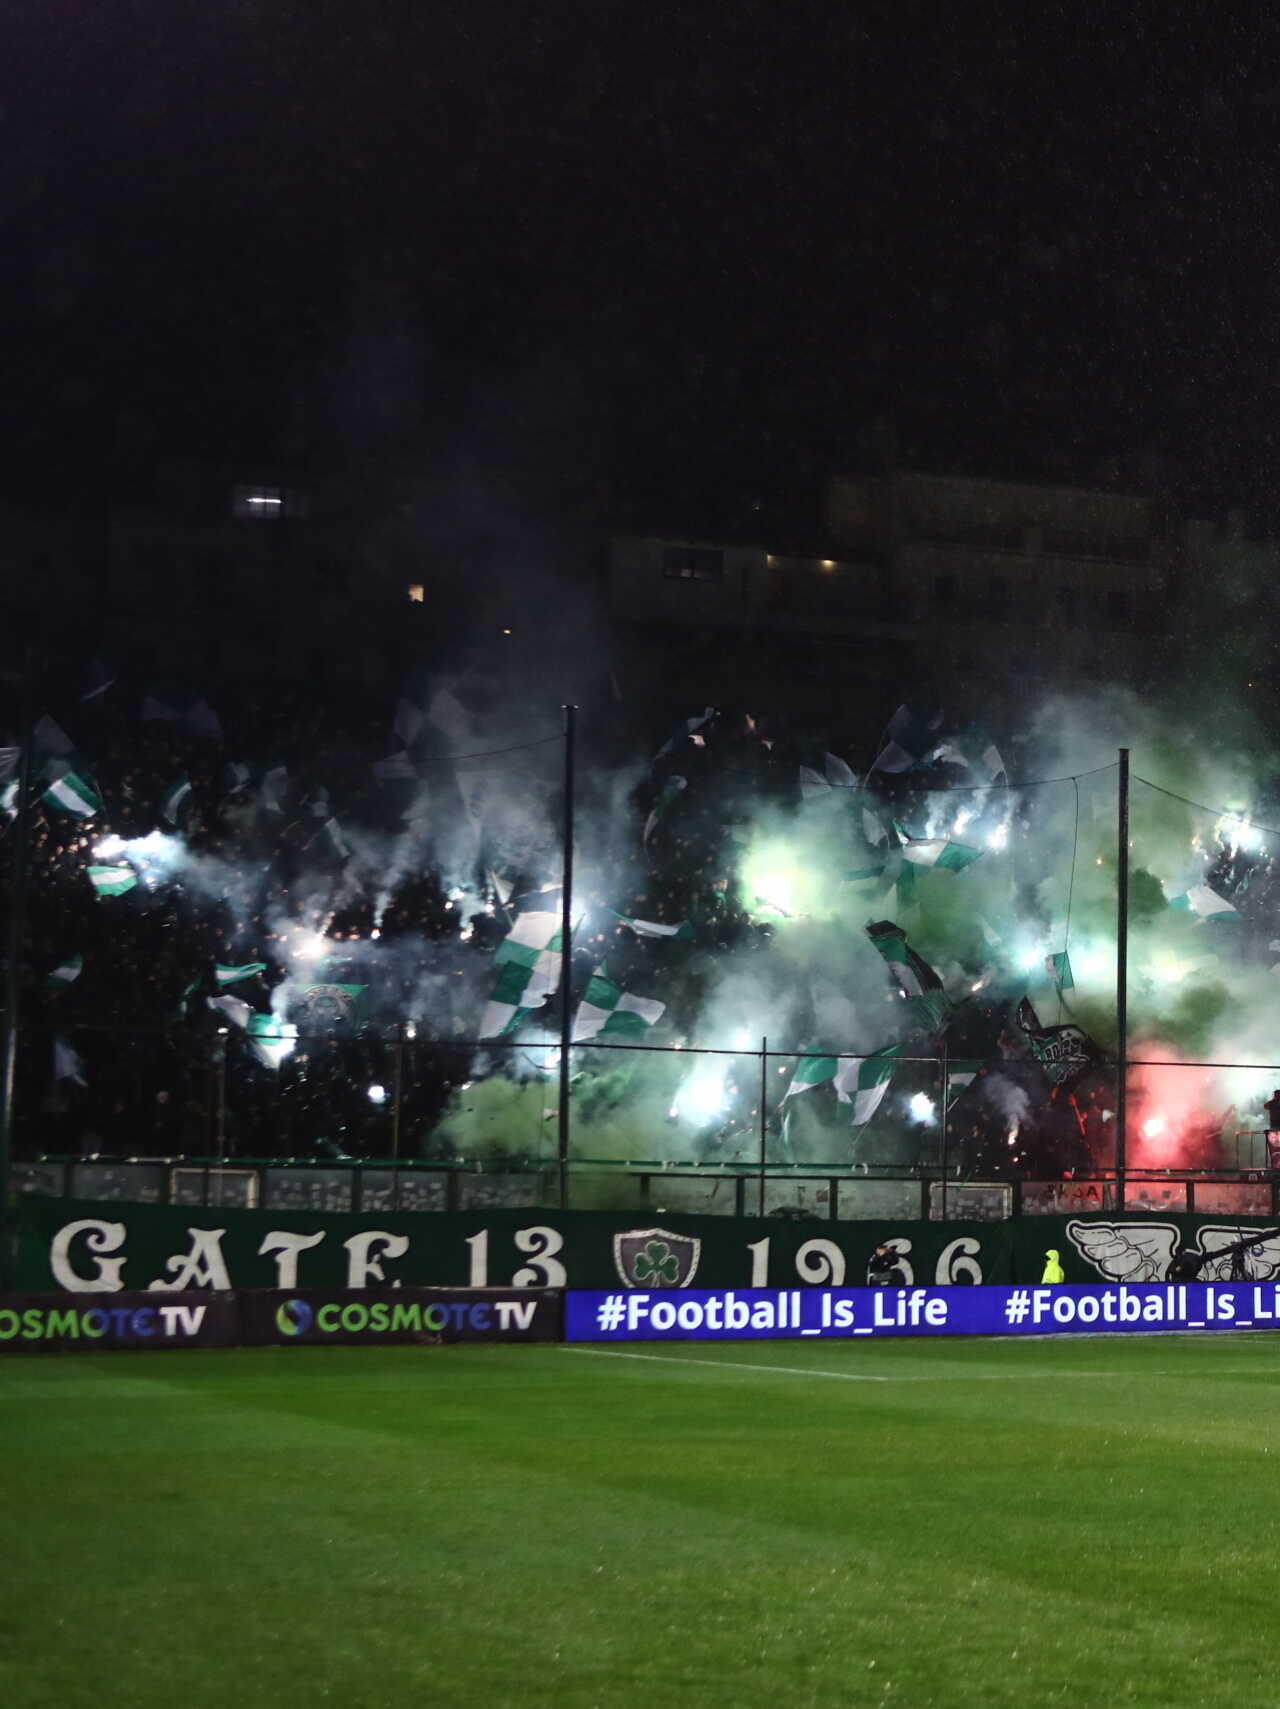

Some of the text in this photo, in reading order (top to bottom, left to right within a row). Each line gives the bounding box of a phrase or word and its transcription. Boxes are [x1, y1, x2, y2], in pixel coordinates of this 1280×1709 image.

[50, 1219, 567, 1293] GATE 13
[159, 1305, 207, 1336] TV
[317, 1301, 537, 1332] COSMOTE TV
[597, 1290, 948, 1334] #Football_Is_Life
